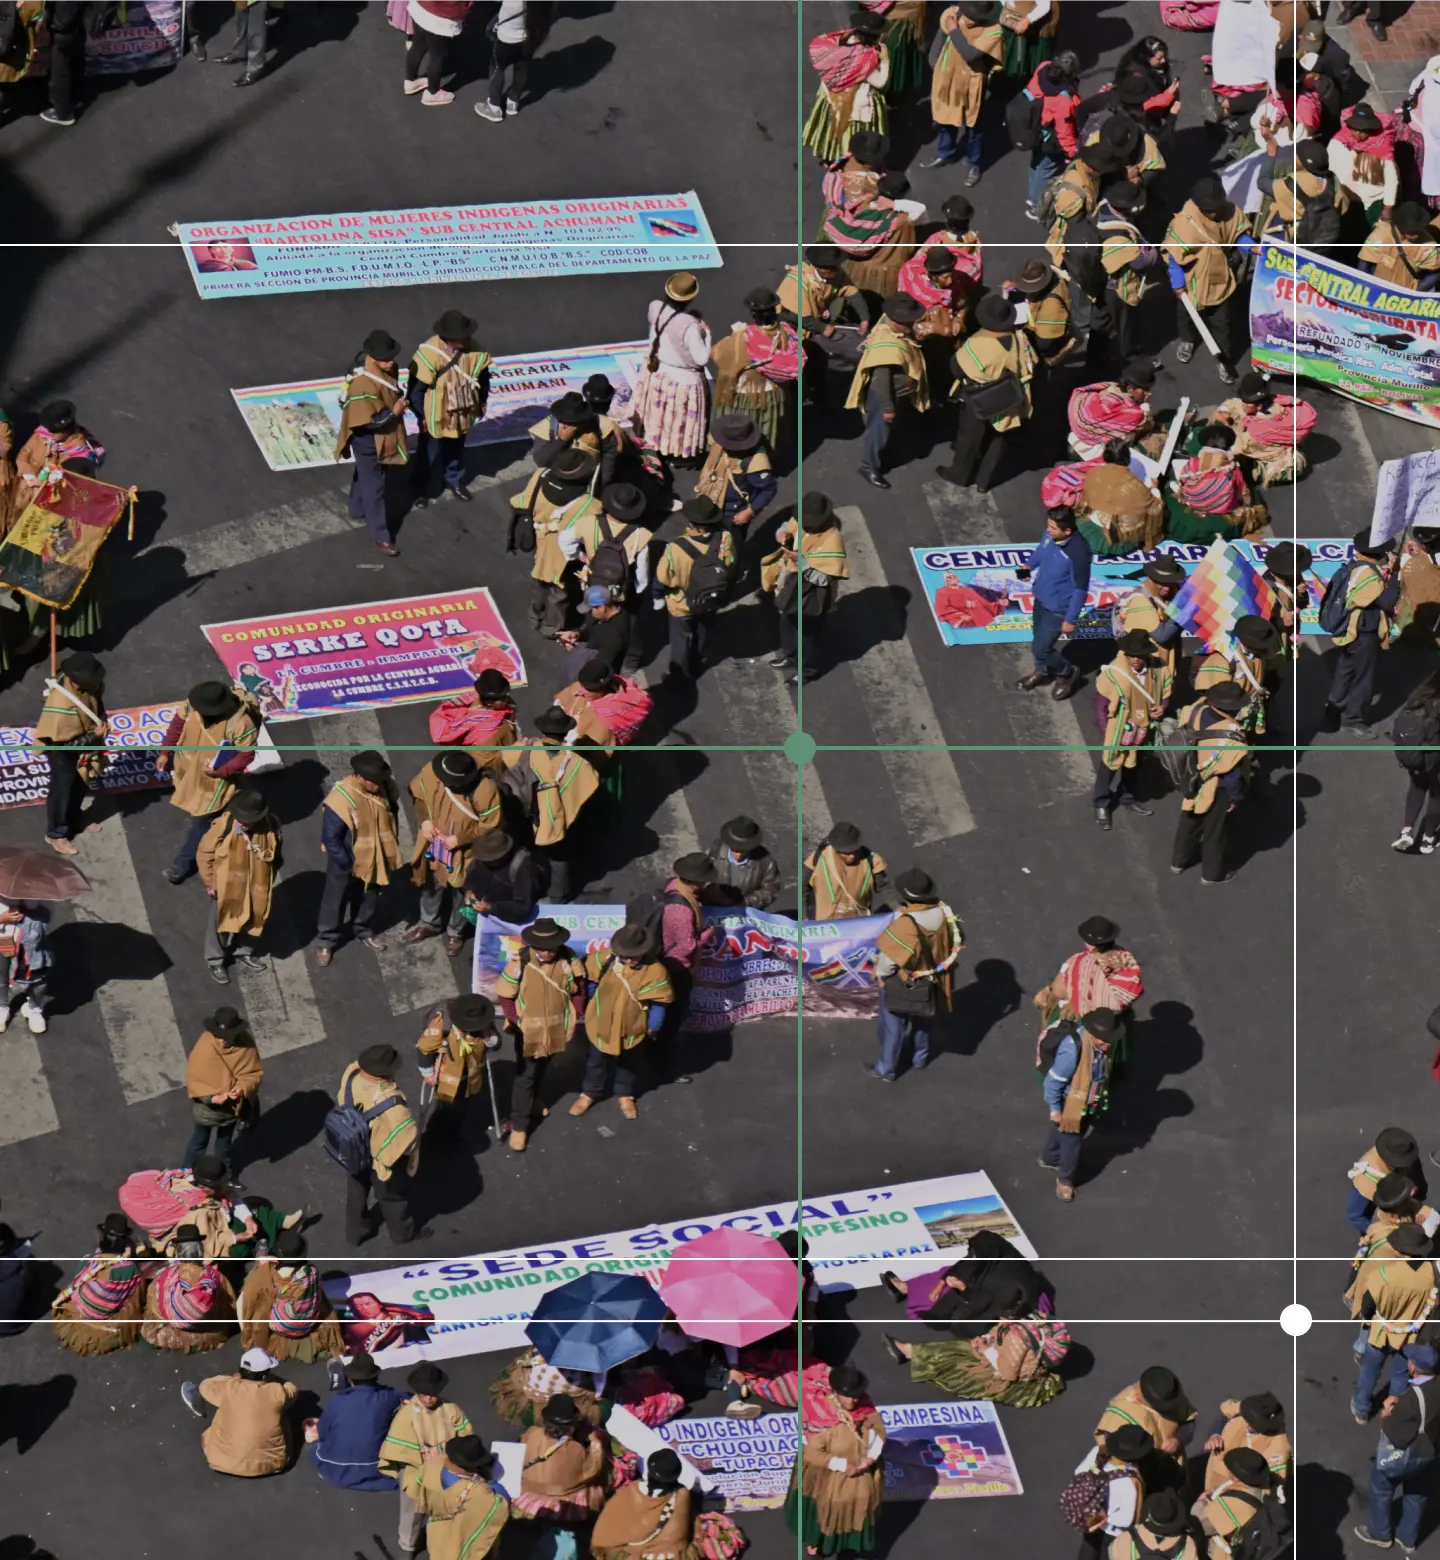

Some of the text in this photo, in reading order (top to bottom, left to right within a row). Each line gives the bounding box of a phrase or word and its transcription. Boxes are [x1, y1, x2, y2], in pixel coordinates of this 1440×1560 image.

[190, 197, 688, 238] ORGANIZACION DE MUJERES INDIGENAS ORIGINARIAS
[420, 223, 454, 236] SUB
[457, 219, 538, 233] CENTRAL
[543, 214, 636, 228] ACHUMANI
[203, 282, 251, 291] PRIMERA
[304, 277, 320, 285] DE
[321, 273, 380, 284] PROVINCIA
[382, 270, 430, 279] MURILLO
[511, 263, 546, 271] PALCA
[548, 259, 569, 268] DEL
[571, 256, 656, 267] DEPARTAMENTO
[691, 253, 713, 261] PAZ
[1265, 246, 1299, 273] SUB
[1299, 263, 1370, 307] CENTRAL
[1276, 277, 1339, 311] SECTOR
[1299, 326, 1362, 349] REFUNDADO
[489, 362, 572, 379] AGRARIA
[1337, 365, 1432, 391] Provincia Murillo
[1407, 367, 1436, 382] Dptal.
[489, 377, 568, 394] CHUMANI
[1339, 379, 1353, 388] LA
[1381, 388, 1425, 401] BOLIVIA
[925, 549, 1036, 569] CENTR
[221, 599, 478, 643] COMUNIDAD ORIGINARIA
[252, 619, 469, 662] SERKE QOTA
[277, 669, 298, 678] LA
[300, 660, 365, 676] CUMBRE
[351, 672, 372, 684] POR
[372, 671, 385, 682] LA
[385, 668, 428, 680] CENTRAL
[333, 688, 346, 698] LA
[347, 682, 385, 696] CUMBRE
[0, 777, 51, 794] PROVIN
[100, 761, 156, 778] URILLO
[103, 774, 150, 789] MAYO
[586, 916, 626, 930] CENT
[747, 999, 794, 1016] MURILLO
[412, 1265, 580, 1303] COMUNIDAD
[585, 1248, 673, 1273] ORIGIN
[427, 1314, 504, 1335] CANTON
[811, 1259, 844, 1269] PTO
[870, 1249, 895, 1261] LA
[896, 1243, 934, 1257] PAZ
[676, 1418, 764, 1440] INDIGENA
[880, 1405, 985, 1427] CAMPESINA
